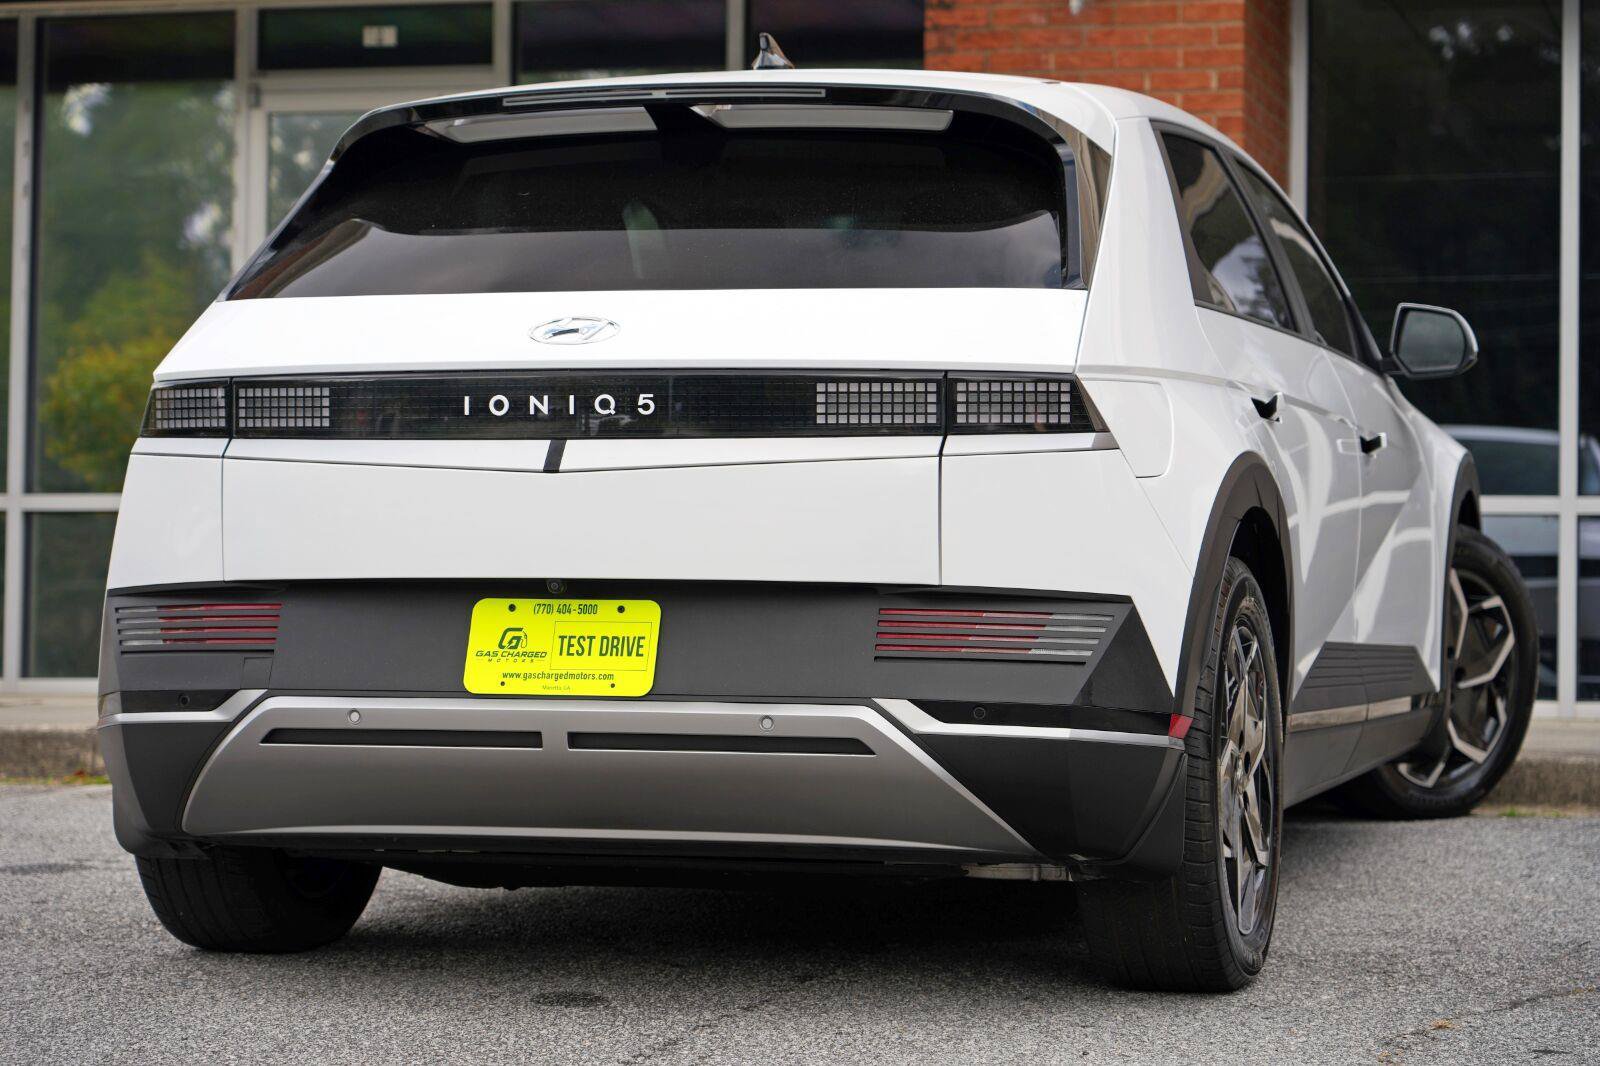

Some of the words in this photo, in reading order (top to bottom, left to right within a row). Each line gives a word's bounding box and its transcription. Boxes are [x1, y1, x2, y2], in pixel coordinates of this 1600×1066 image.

[464, 393, 616, 416] IONIQ
[637, 393, 656, 415] 5
[533, 603, 554, 614] (770)
[556, 604, 598, 615] 404-5000
[558, 635, 596, 657] TEST
[599, 636, 646, 658] DRIVE
[475, 650, 499, 658] GAS
[502, 671, 615, 682] www.gaschargedmotors.com
